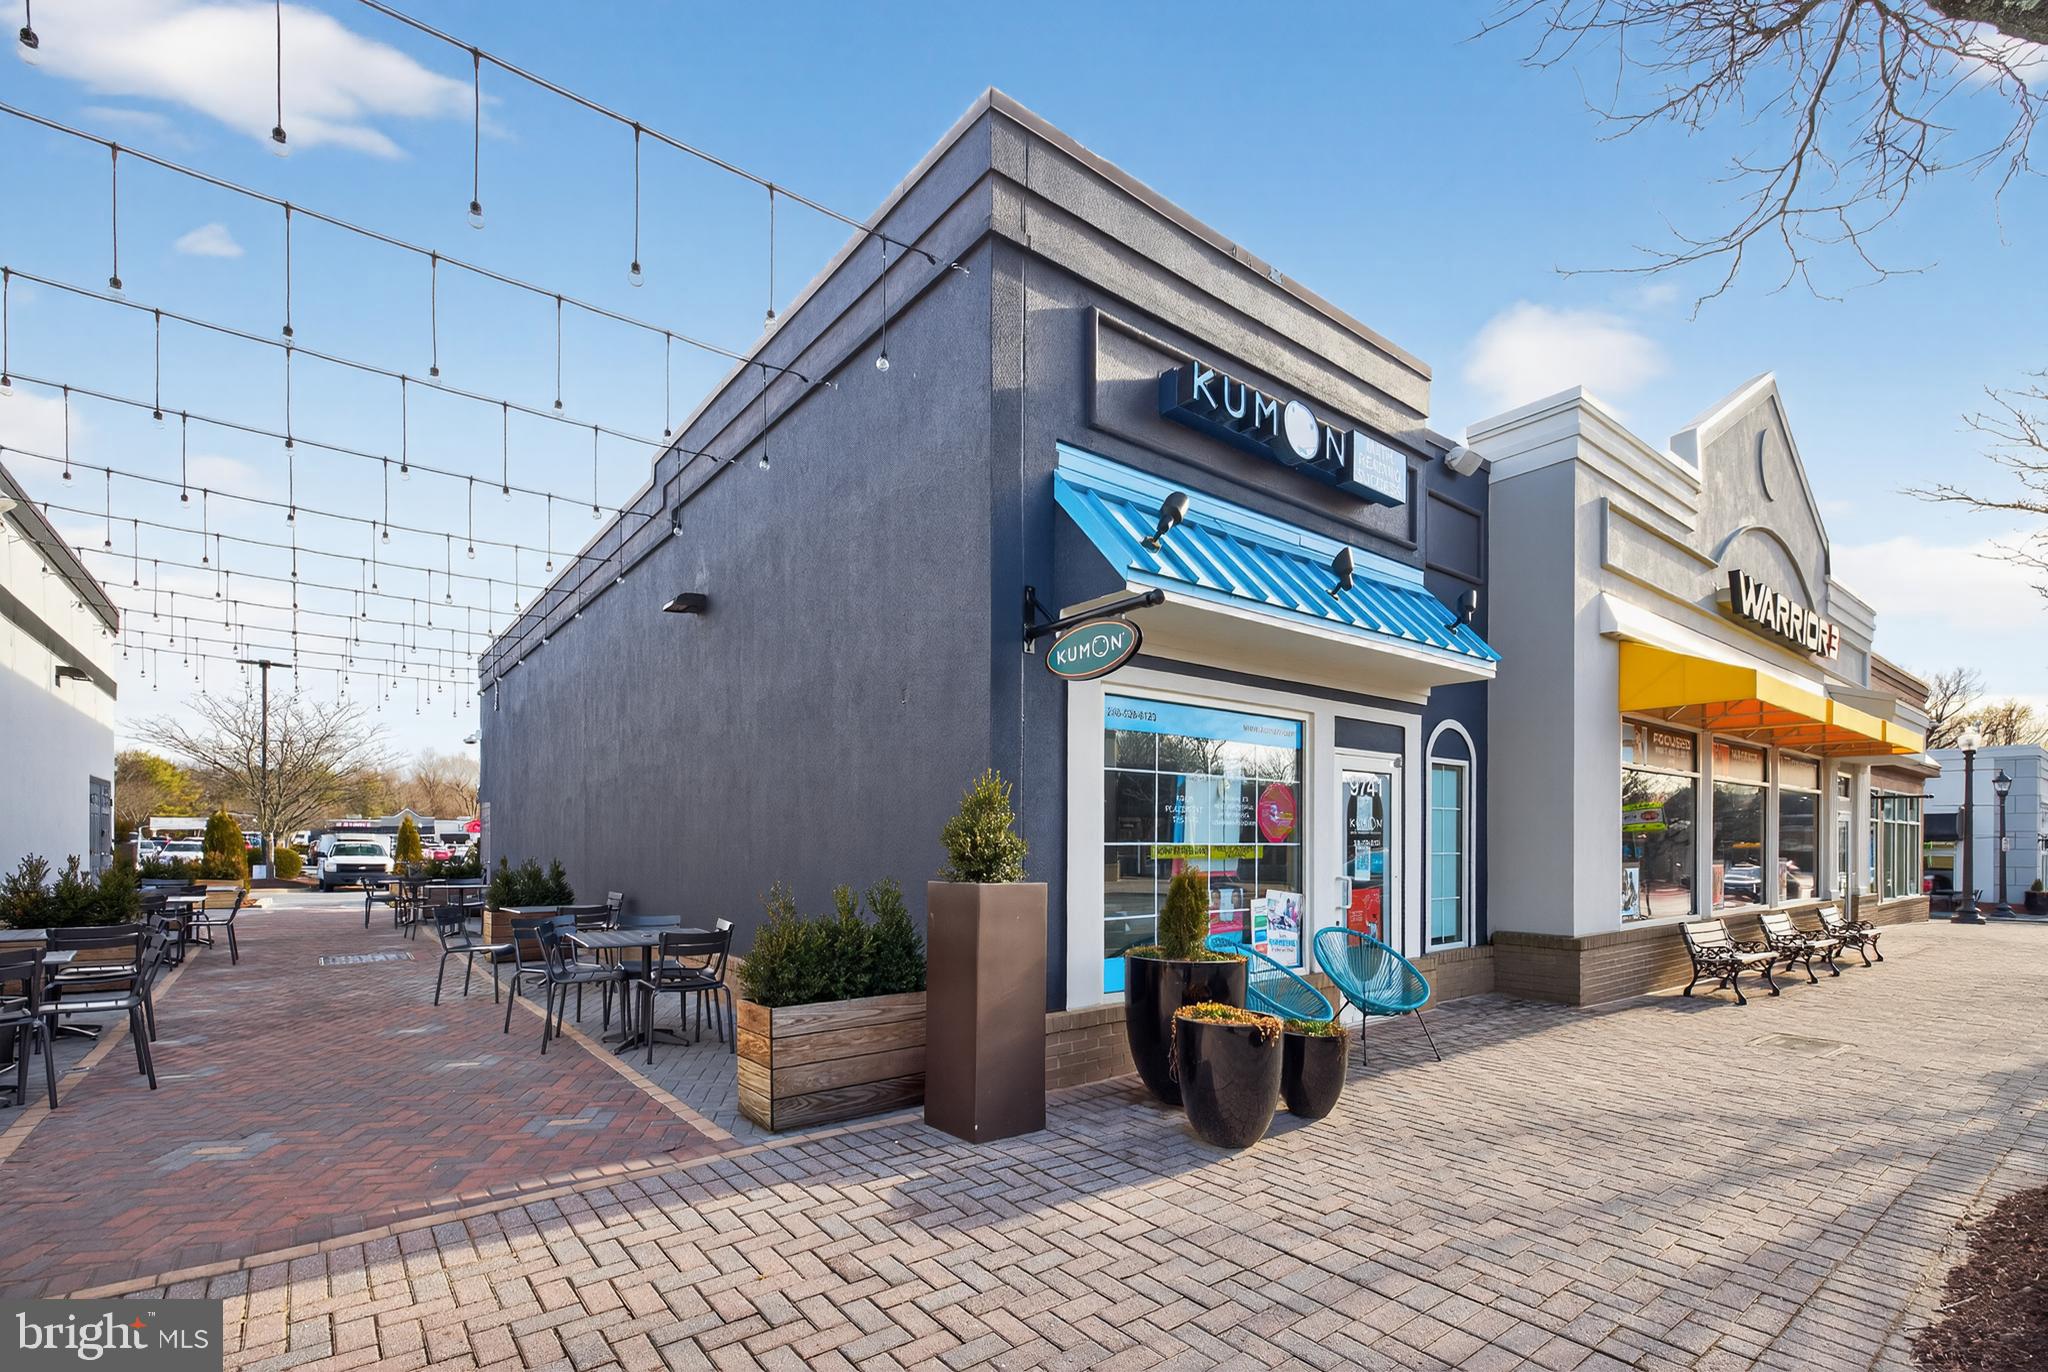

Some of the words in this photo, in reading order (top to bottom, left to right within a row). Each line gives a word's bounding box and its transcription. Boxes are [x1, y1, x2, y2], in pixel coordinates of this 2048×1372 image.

[1193, 360, 1345, 467] KUMON
[1056, 633, 1122, 665] KUMON
[1349, 777, 1383, 798] 9741
